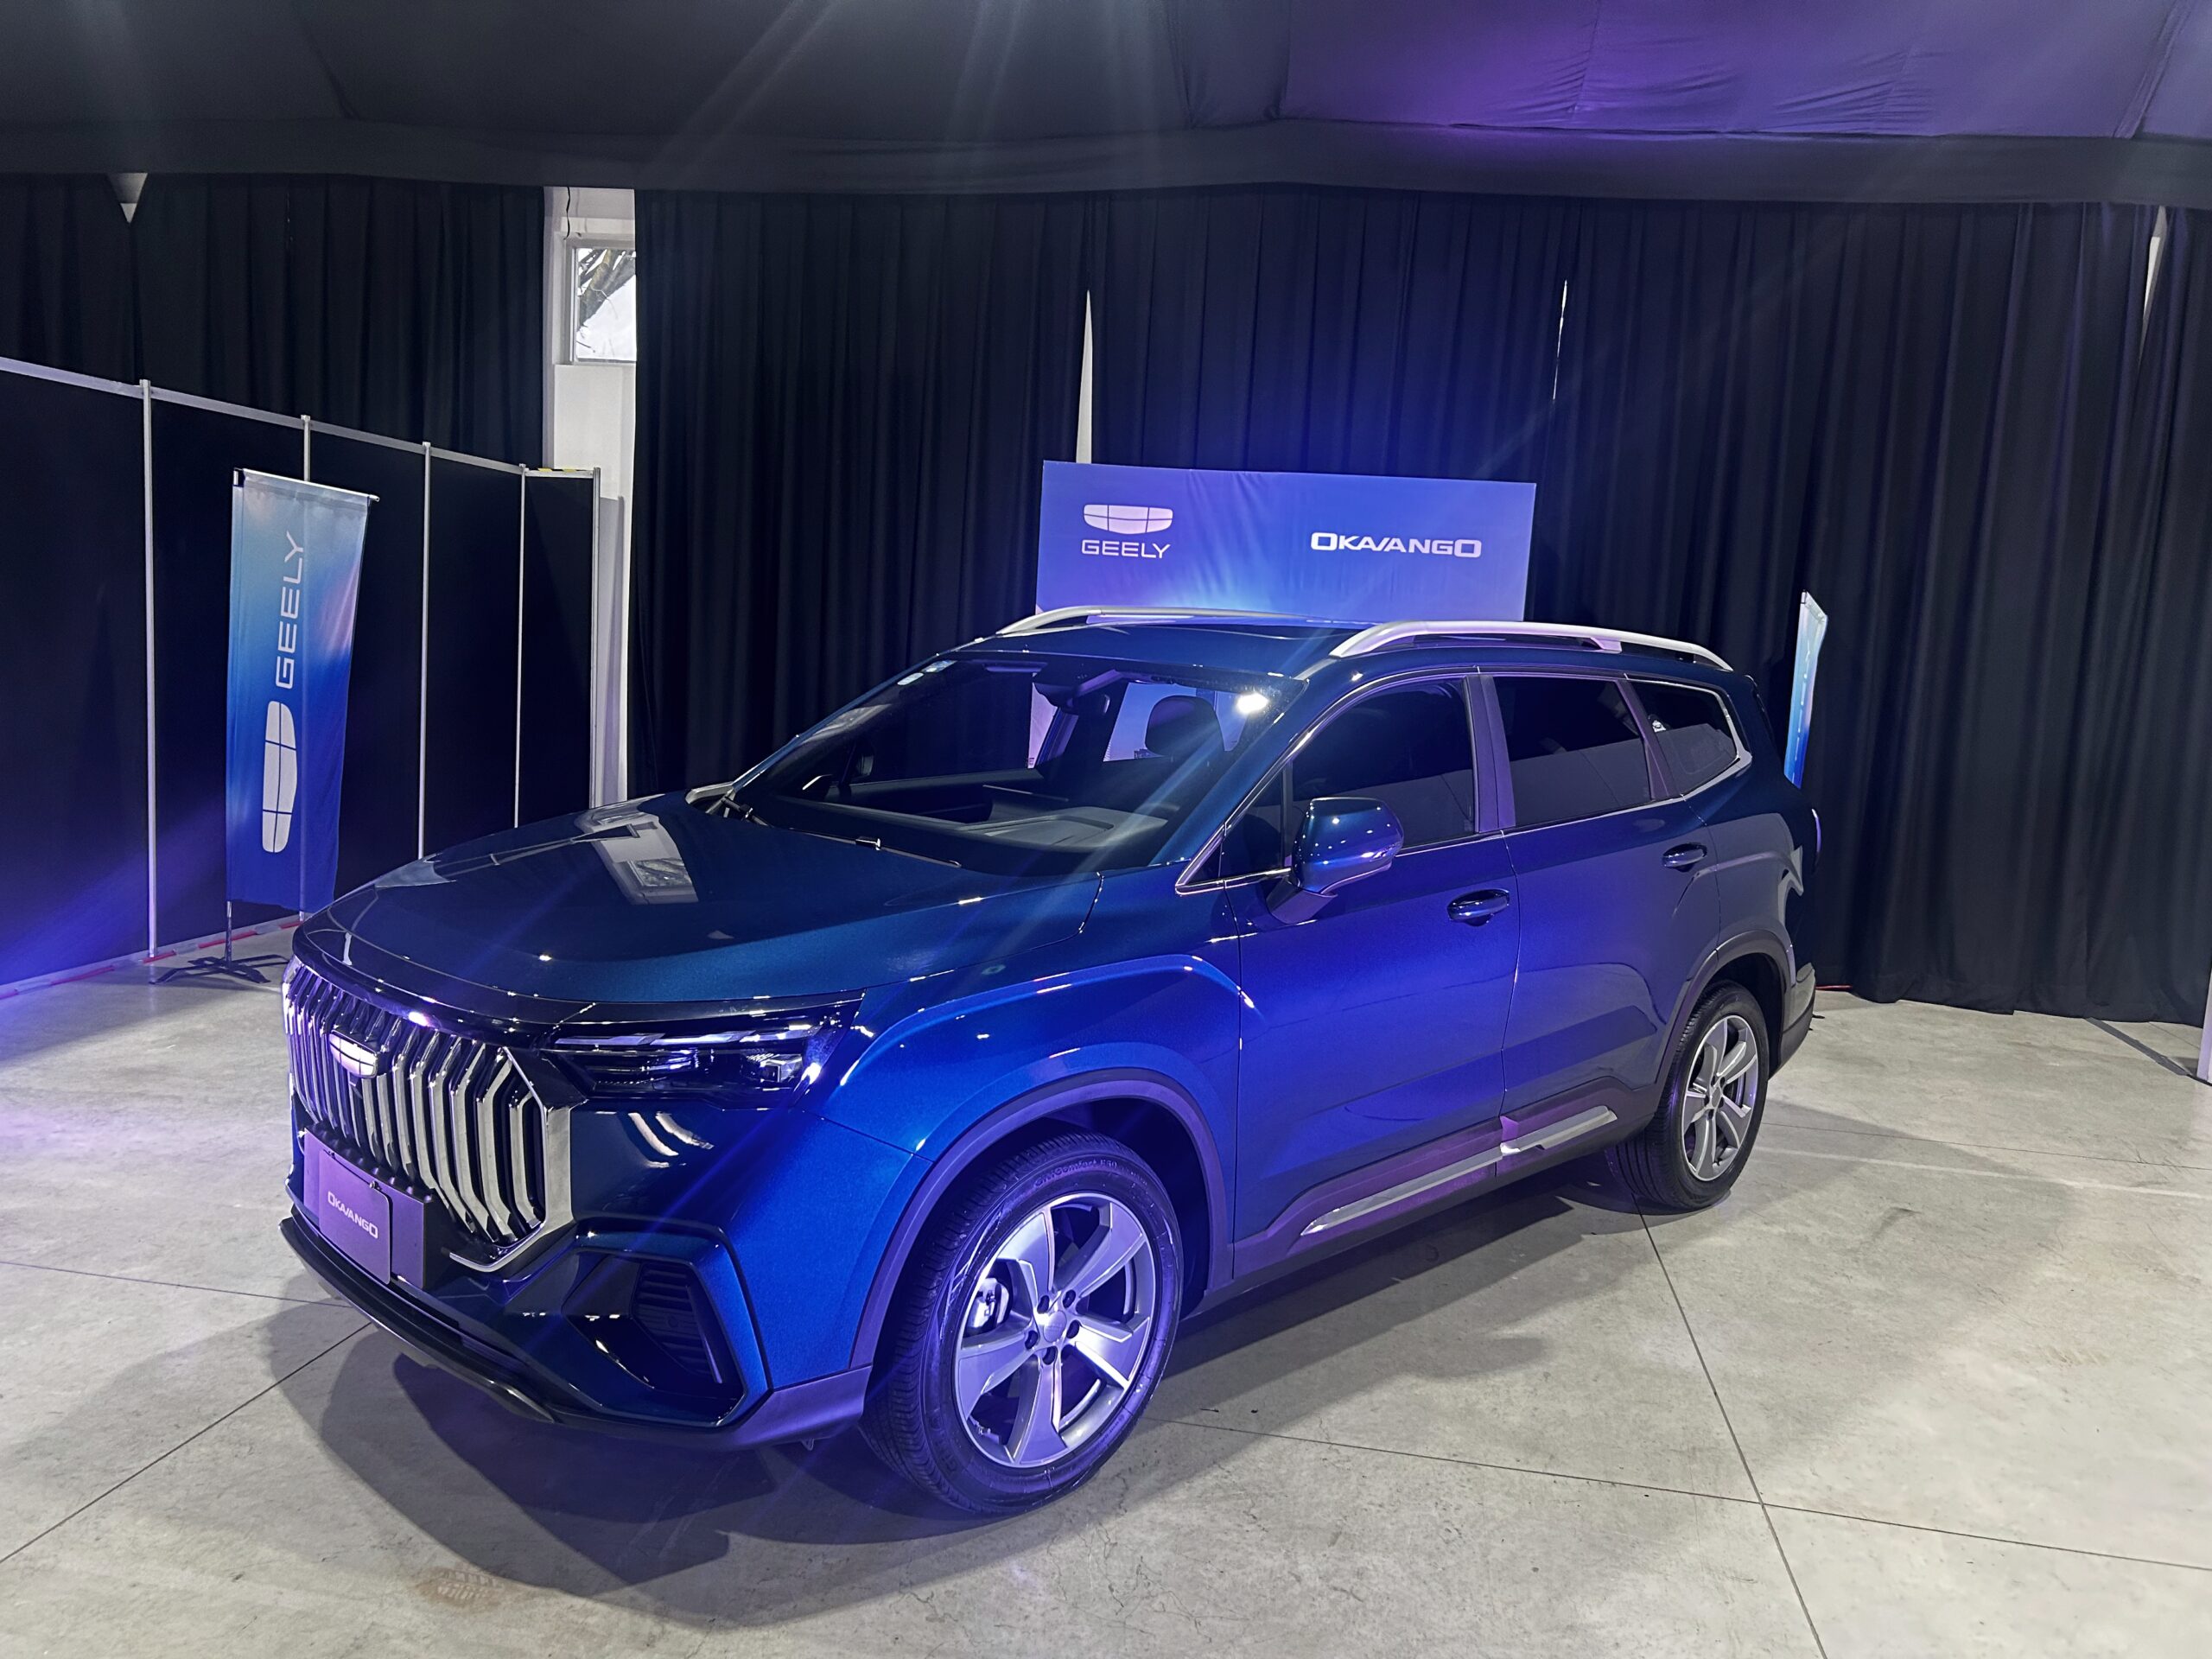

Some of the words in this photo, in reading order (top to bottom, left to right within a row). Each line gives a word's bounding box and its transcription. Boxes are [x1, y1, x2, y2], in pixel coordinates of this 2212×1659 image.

[1081, 539, 1170, 558] GEELY
[1310, 532, 1481, 557] OKAVANGO
[276, 531, 303, 689] GEELY
